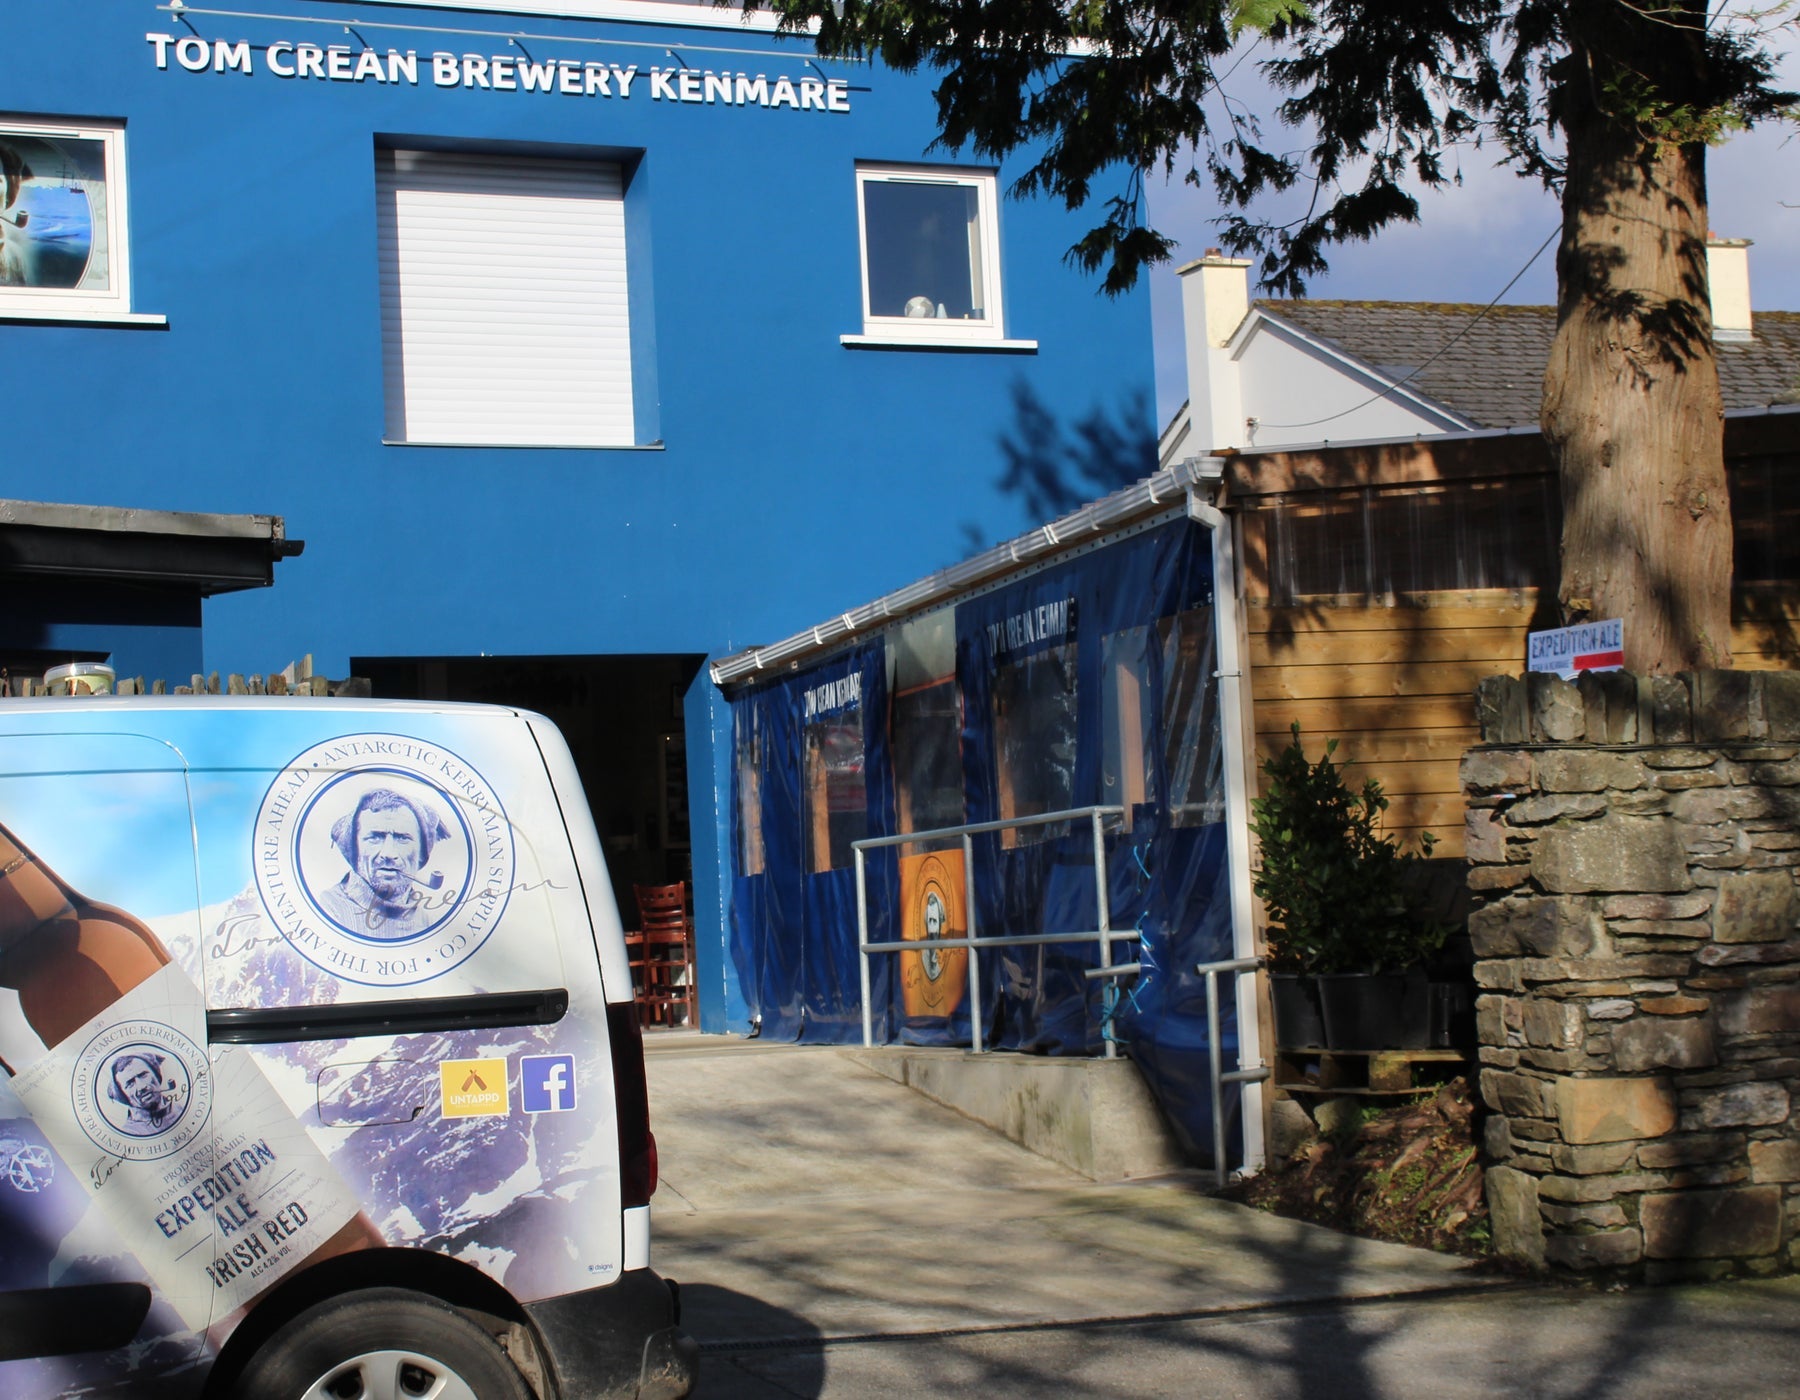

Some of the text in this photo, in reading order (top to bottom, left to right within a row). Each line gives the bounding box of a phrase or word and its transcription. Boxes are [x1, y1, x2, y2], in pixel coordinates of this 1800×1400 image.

[147, 33, 850, 113] TOM CREAN BREWERY KENMARE
[1532, 623, 1620, 659] EXPEDITION ALE
[264, 767, 418, 976] FOR THE ADVENTURE AHEAD
[323, 741, 505, 959] ANTARCTIC KERRYMAN SUPPLY CO.
[212, 913, 300, 959] Tom
[87, 1026, 137, 1066] ANTARCTIC
[140, 1025, 197, 1059] KERRYMAN
[194, 1059, 210, 1098] SUPPLY
[77, 1074, 87, 1113] AHEAD
[450, 1093, 500, 1105] UNTAPPD
[84, 1112, 143, 1155] ADVENTURE
[146, 1141, 169, 1155] THE
[170, 1127, 192, 1146] FOR
[154, 1185, 178, 1205] TOM
[215, 1132, 248, 1160] FAMILY
[163, 1133, 225, 1184] PRODUCED BY
[154, 1138, 276, 1239] EXPEDITION
[215, 1193, 259, 1237] ALE
[206, 1232, 268, 1288] IRISH
[262, 1201, 309, 1246] RED
[251, 1265, 264, 1278] ALC
[277, 1244, 292, 1257] VOL
